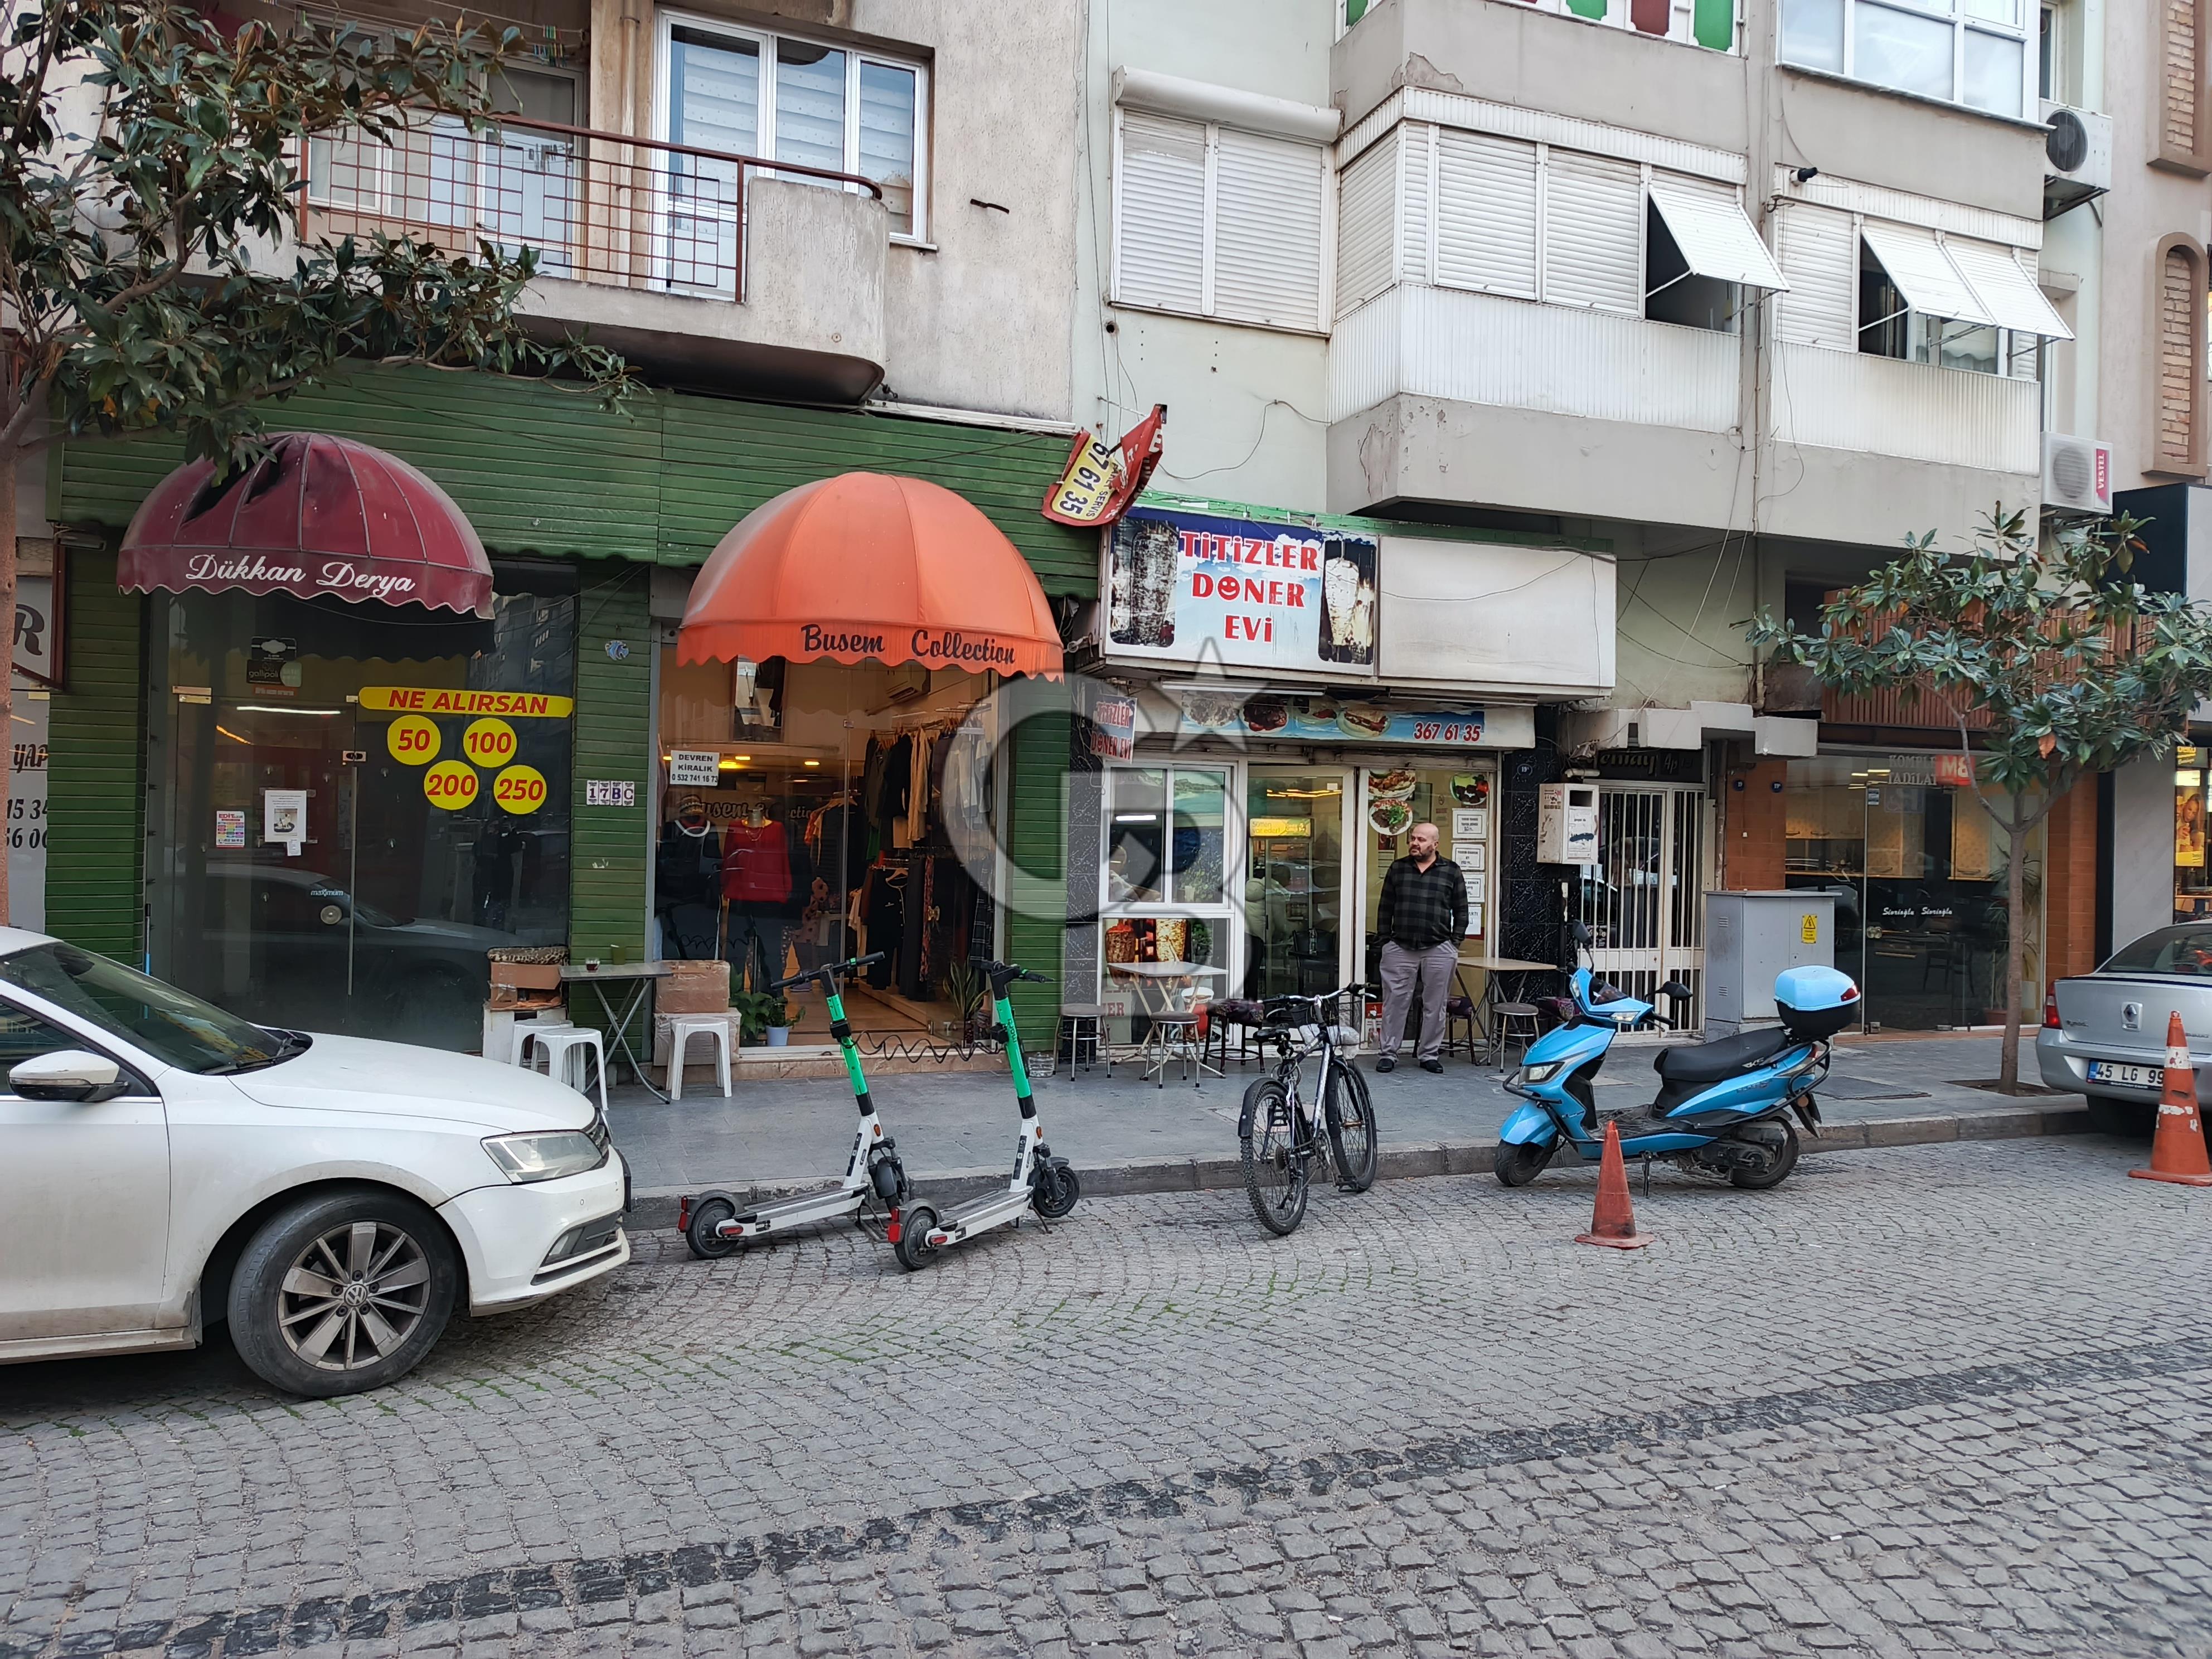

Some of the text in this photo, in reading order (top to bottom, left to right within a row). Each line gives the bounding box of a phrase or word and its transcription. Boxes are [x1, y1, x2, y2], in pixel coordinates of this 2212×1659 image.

[1073, 467, 1102, 492] 61
[1060, 491, 1089, 515] 35
[185, 554, 416, 598] Dükkan Derya
[801, 623, 1016, 664] Busem Collection
[389, 690, 549, 715] NE ALIRSAN
[397, 729, 431, 751] 50
[467, 731, 512, 754] 100
[1414, 722, 1481, 742] 367 61 35
[678, 754, 714, 762] DEVREN
[426, 774, 477, 796] 200
[677, 773, 688, 782] 532
[497, 779, 544, 802] 250
[704, 802, 748, 818] usem
[2097, 1063, 2113, 1079] 45
[2122, 1066, 2139, 1081] LG
